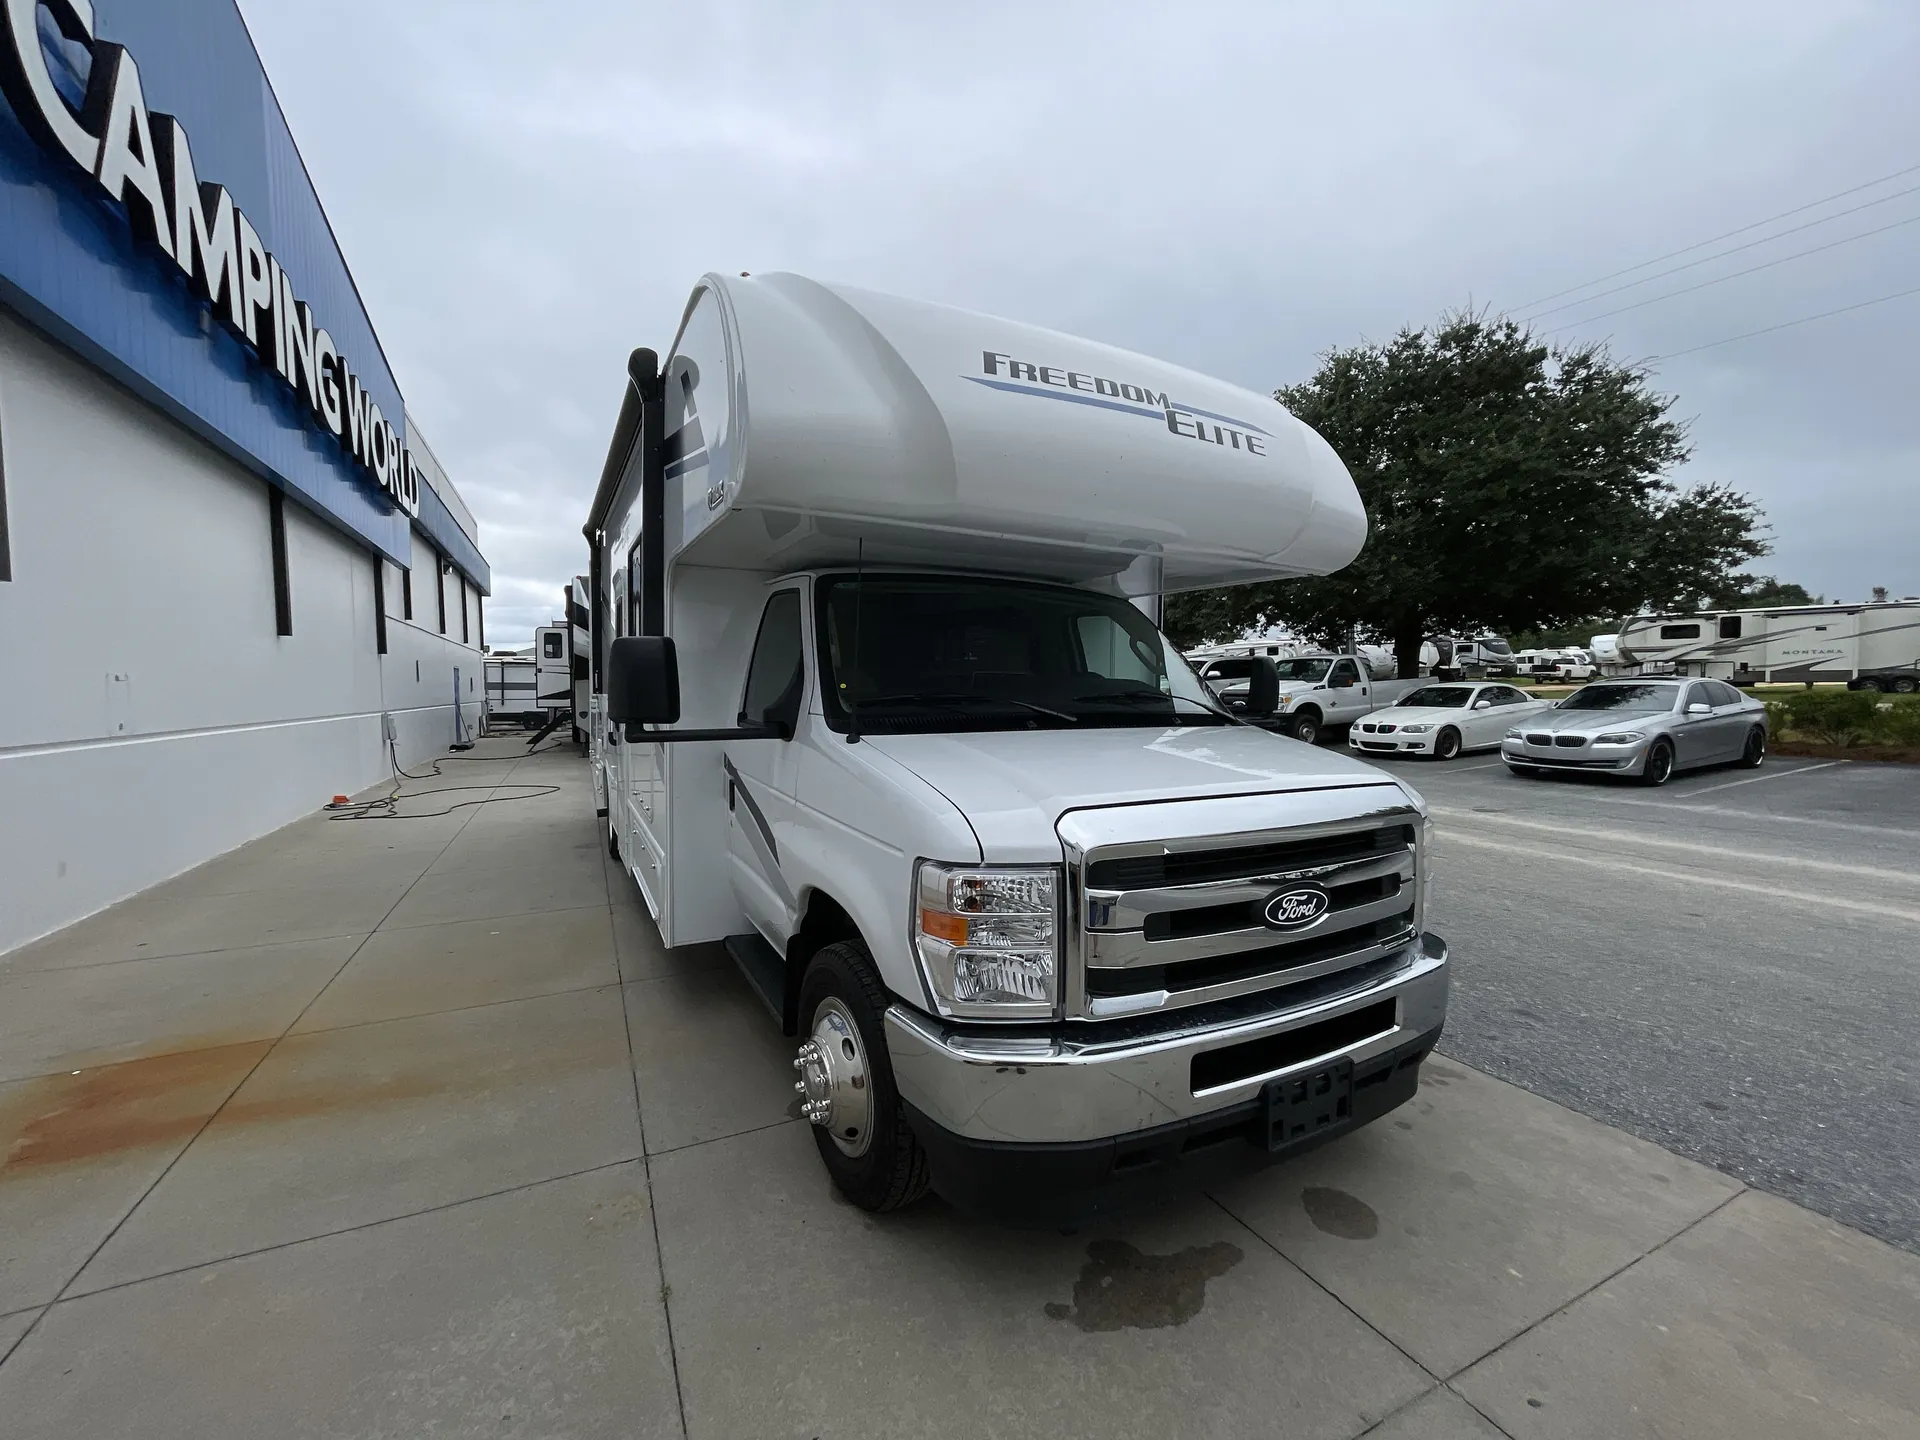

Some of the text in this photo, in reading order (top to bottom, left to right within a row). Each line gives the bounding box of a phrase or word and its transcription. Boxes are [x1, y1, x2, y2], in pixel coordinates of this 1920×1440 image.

[5, 0, 419, 518] CAMPING WORLD
[982, 351, 1171, 409] FREEDOM
[1164, 409, 1266, 457] ELITE
[1278, 894, 1317, 920] Ford
